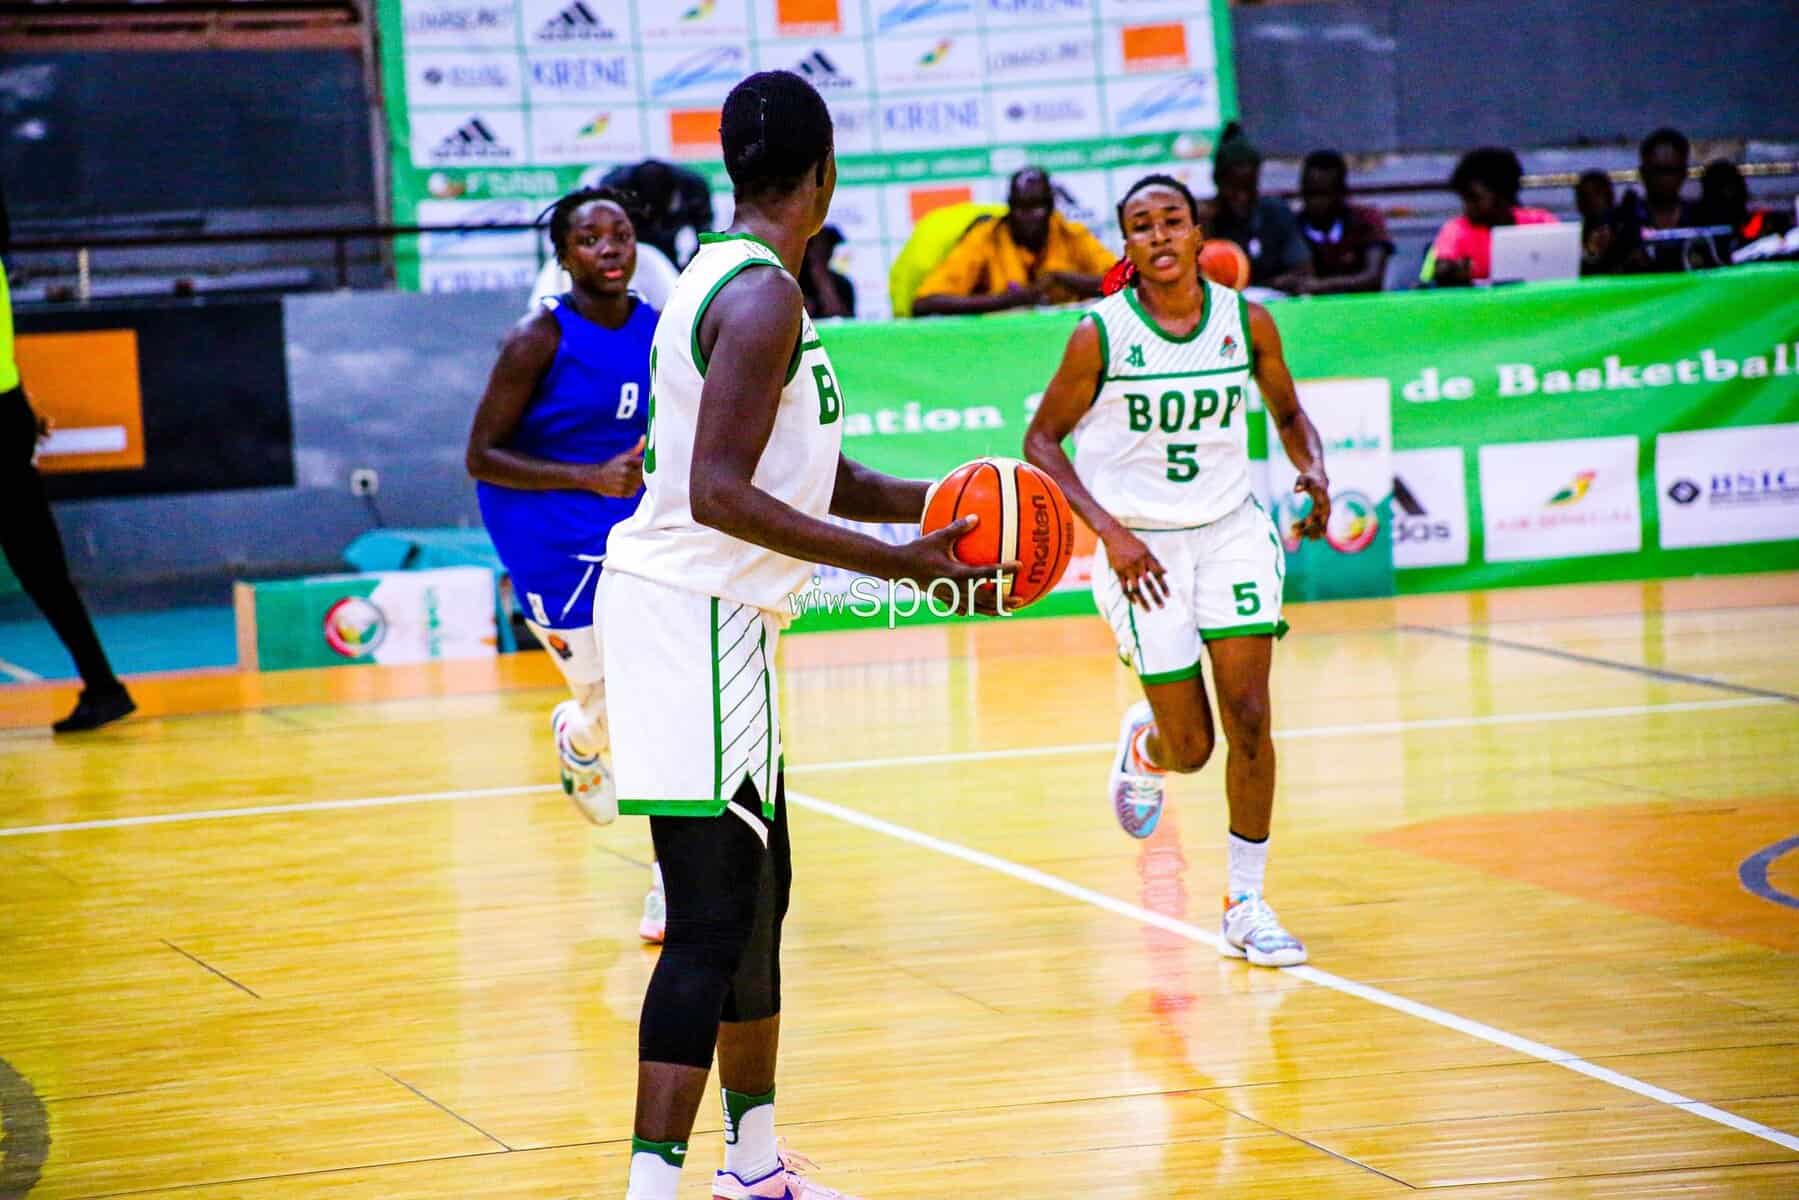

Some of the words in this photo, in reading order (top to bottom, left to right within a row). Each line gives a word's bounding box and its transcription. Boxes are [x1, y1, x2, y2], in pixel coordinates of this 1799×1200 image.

[811, 363, 841, 426] B
[1401, 367, 1476, 403] de
[1123, 384, 1242, 434] BOPP
[1166, 443, 1200, 483] 5
[1027, 494, 1050, 584] molten
[1232, 581, 1261, 617] 5
